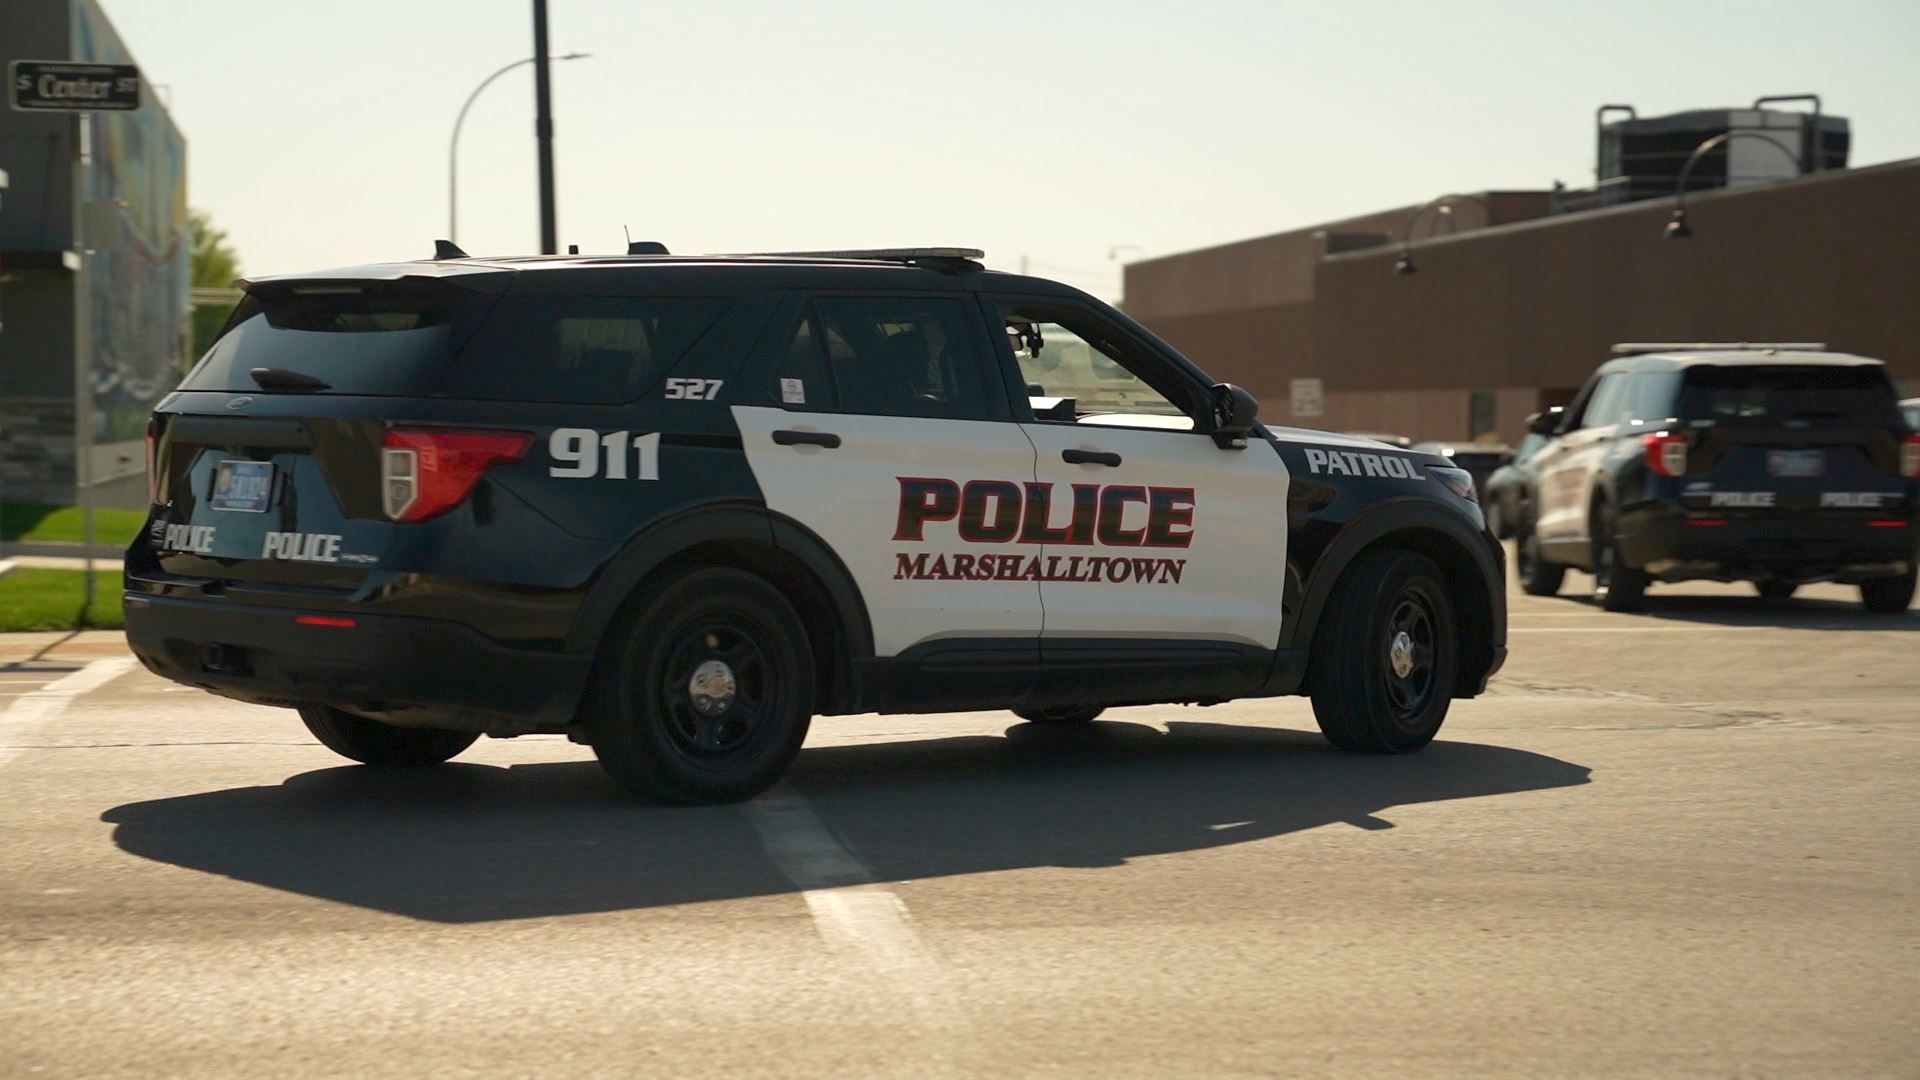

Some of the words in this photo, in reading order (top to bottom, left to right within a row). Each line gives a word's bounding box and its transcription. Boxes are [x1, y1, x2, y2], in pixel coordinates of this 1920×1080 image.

[38, 73, 113, 99] Center
[665, 378, 723, 400] 527
[550, 428, 660, 480] 911
[1304, 448, 1426, 481] PATROL
[891, 476, 1196, 548] POLICE
[163, 524, 216, 553] POLICE
[262, 532, 342, 562] POLICE
[893, 552, 1186, 584] MARSHALLTOWN
